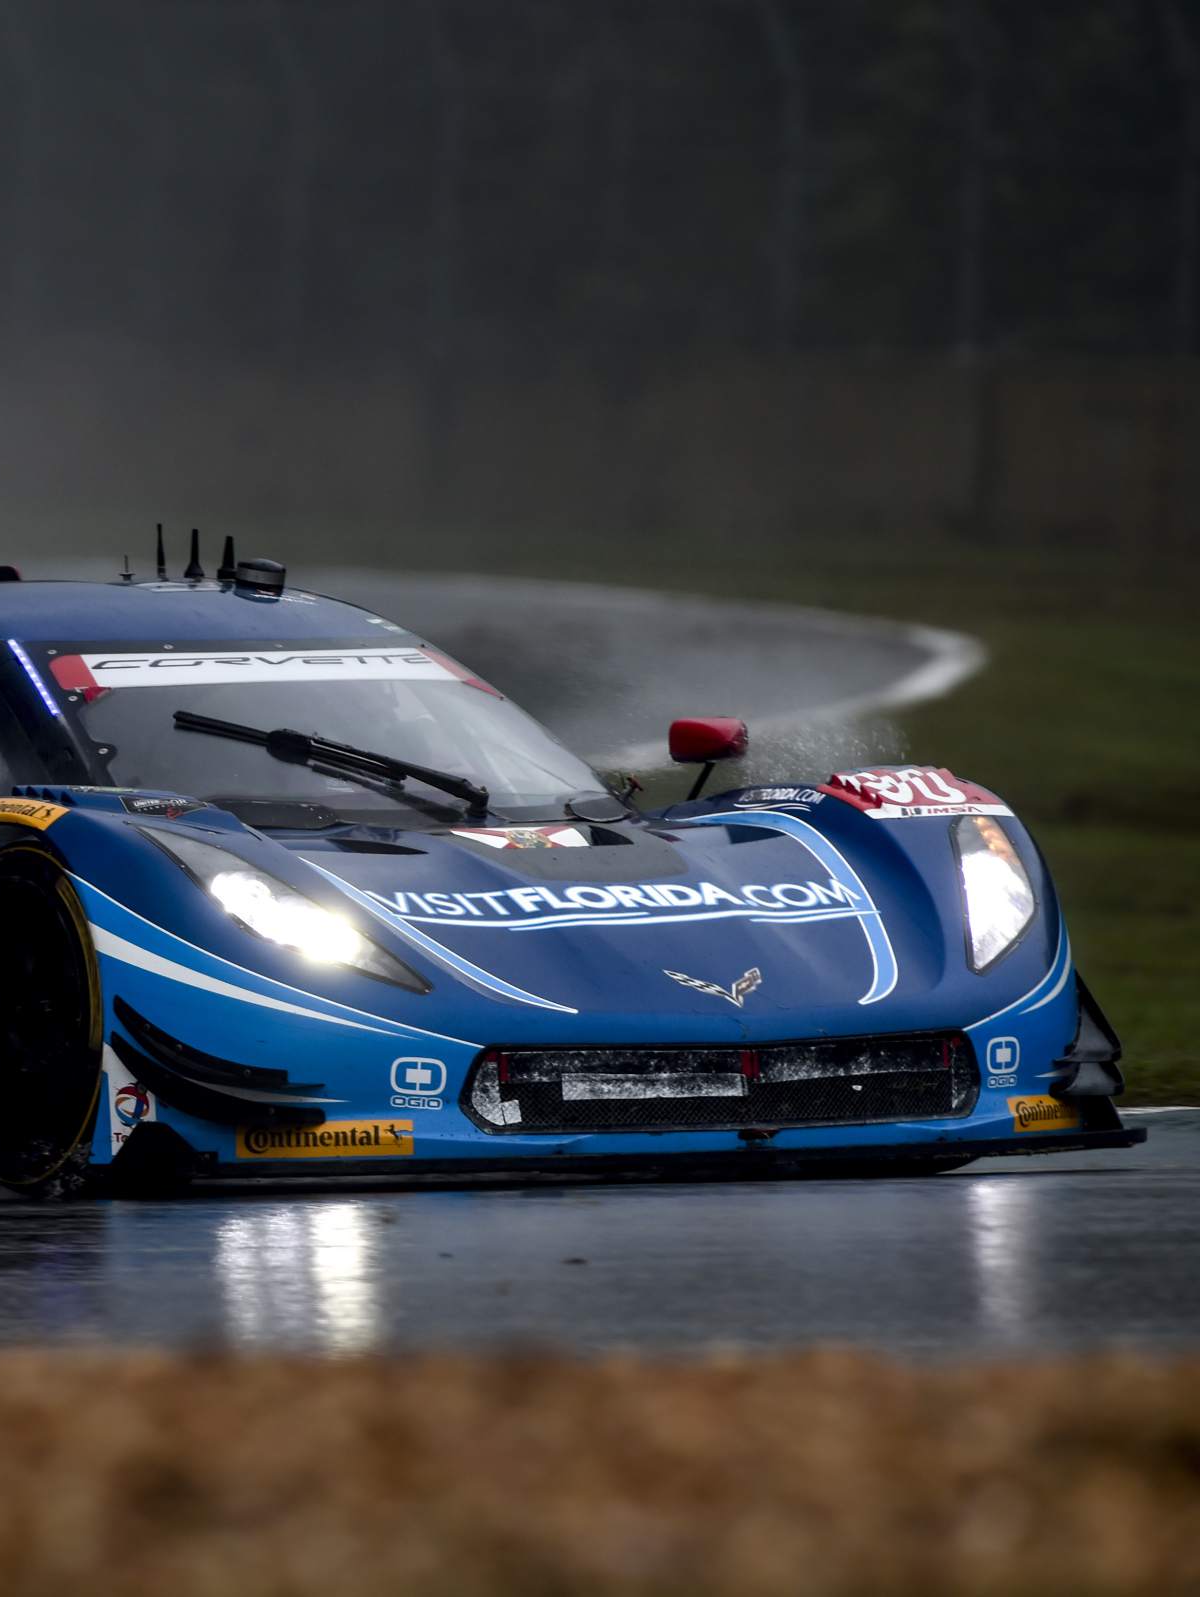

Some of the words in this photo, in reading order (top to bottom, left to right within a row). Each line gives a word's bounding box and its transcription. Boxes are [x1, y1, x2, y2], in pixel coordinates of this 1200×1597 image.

[91, 653, 433, 670] CORVETTE
[363, 878, 862, 916] VISITFLORIDA.COM
[391, 1095, 443, 1110] OGIO
[1016, 1101, 1072, 1128] Contine
[244, 1124, 381, 1154] Continental
